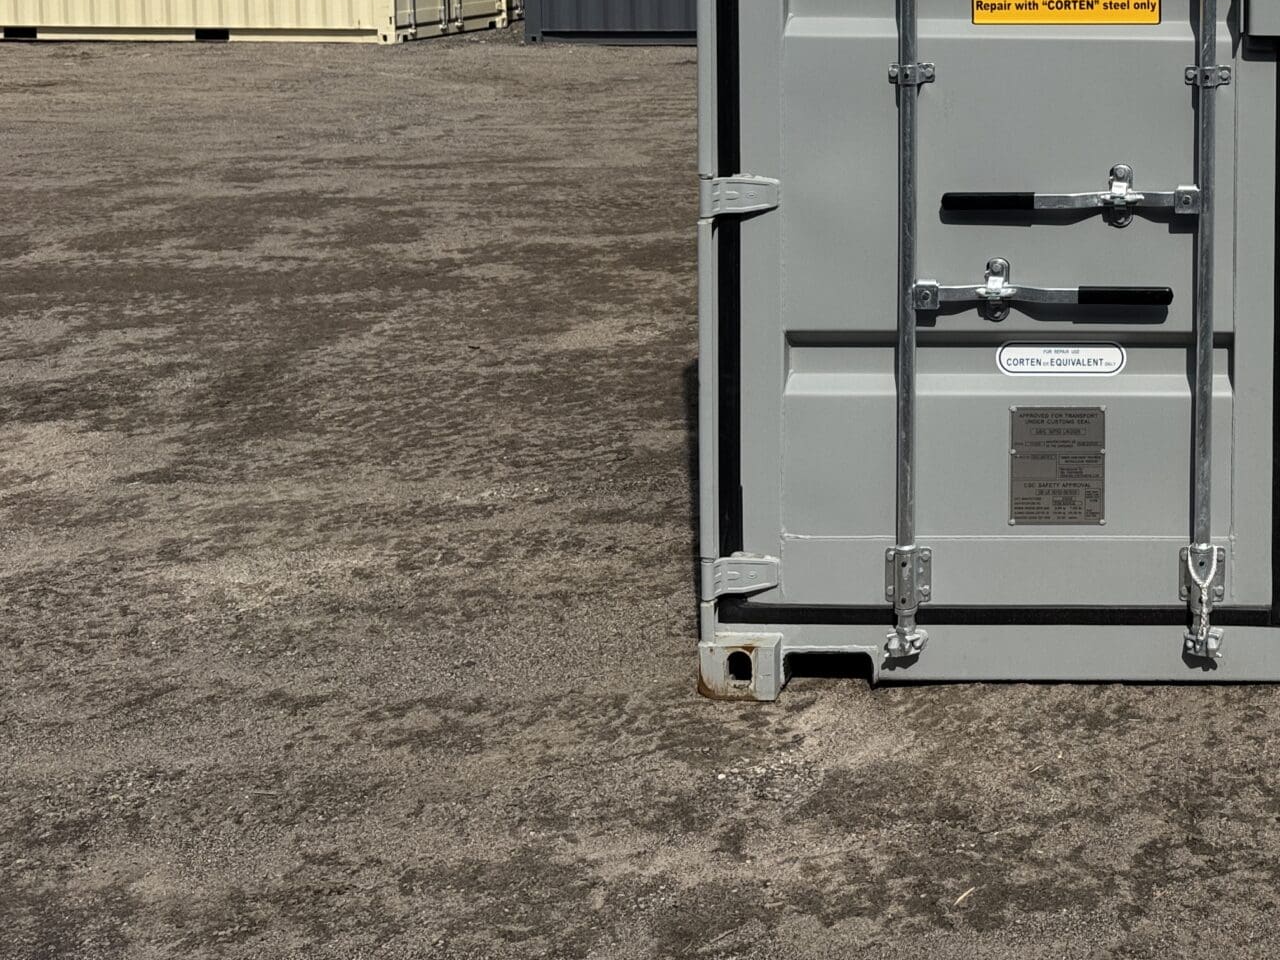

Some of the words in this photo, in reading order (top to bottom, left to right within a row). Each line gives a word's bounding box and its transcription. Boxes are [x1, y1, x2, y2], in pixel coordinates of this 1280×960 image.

[975, 0, 1011, 13] Repair
[1015, 0, 1039, 10] with
[1103, 0, 1130, 10] steel
[1133, 0, 1157, 12] only
[1006, 358, 1042, 367] CORTEN
[1050, 358, 1104, 367] EQUIVALENT
